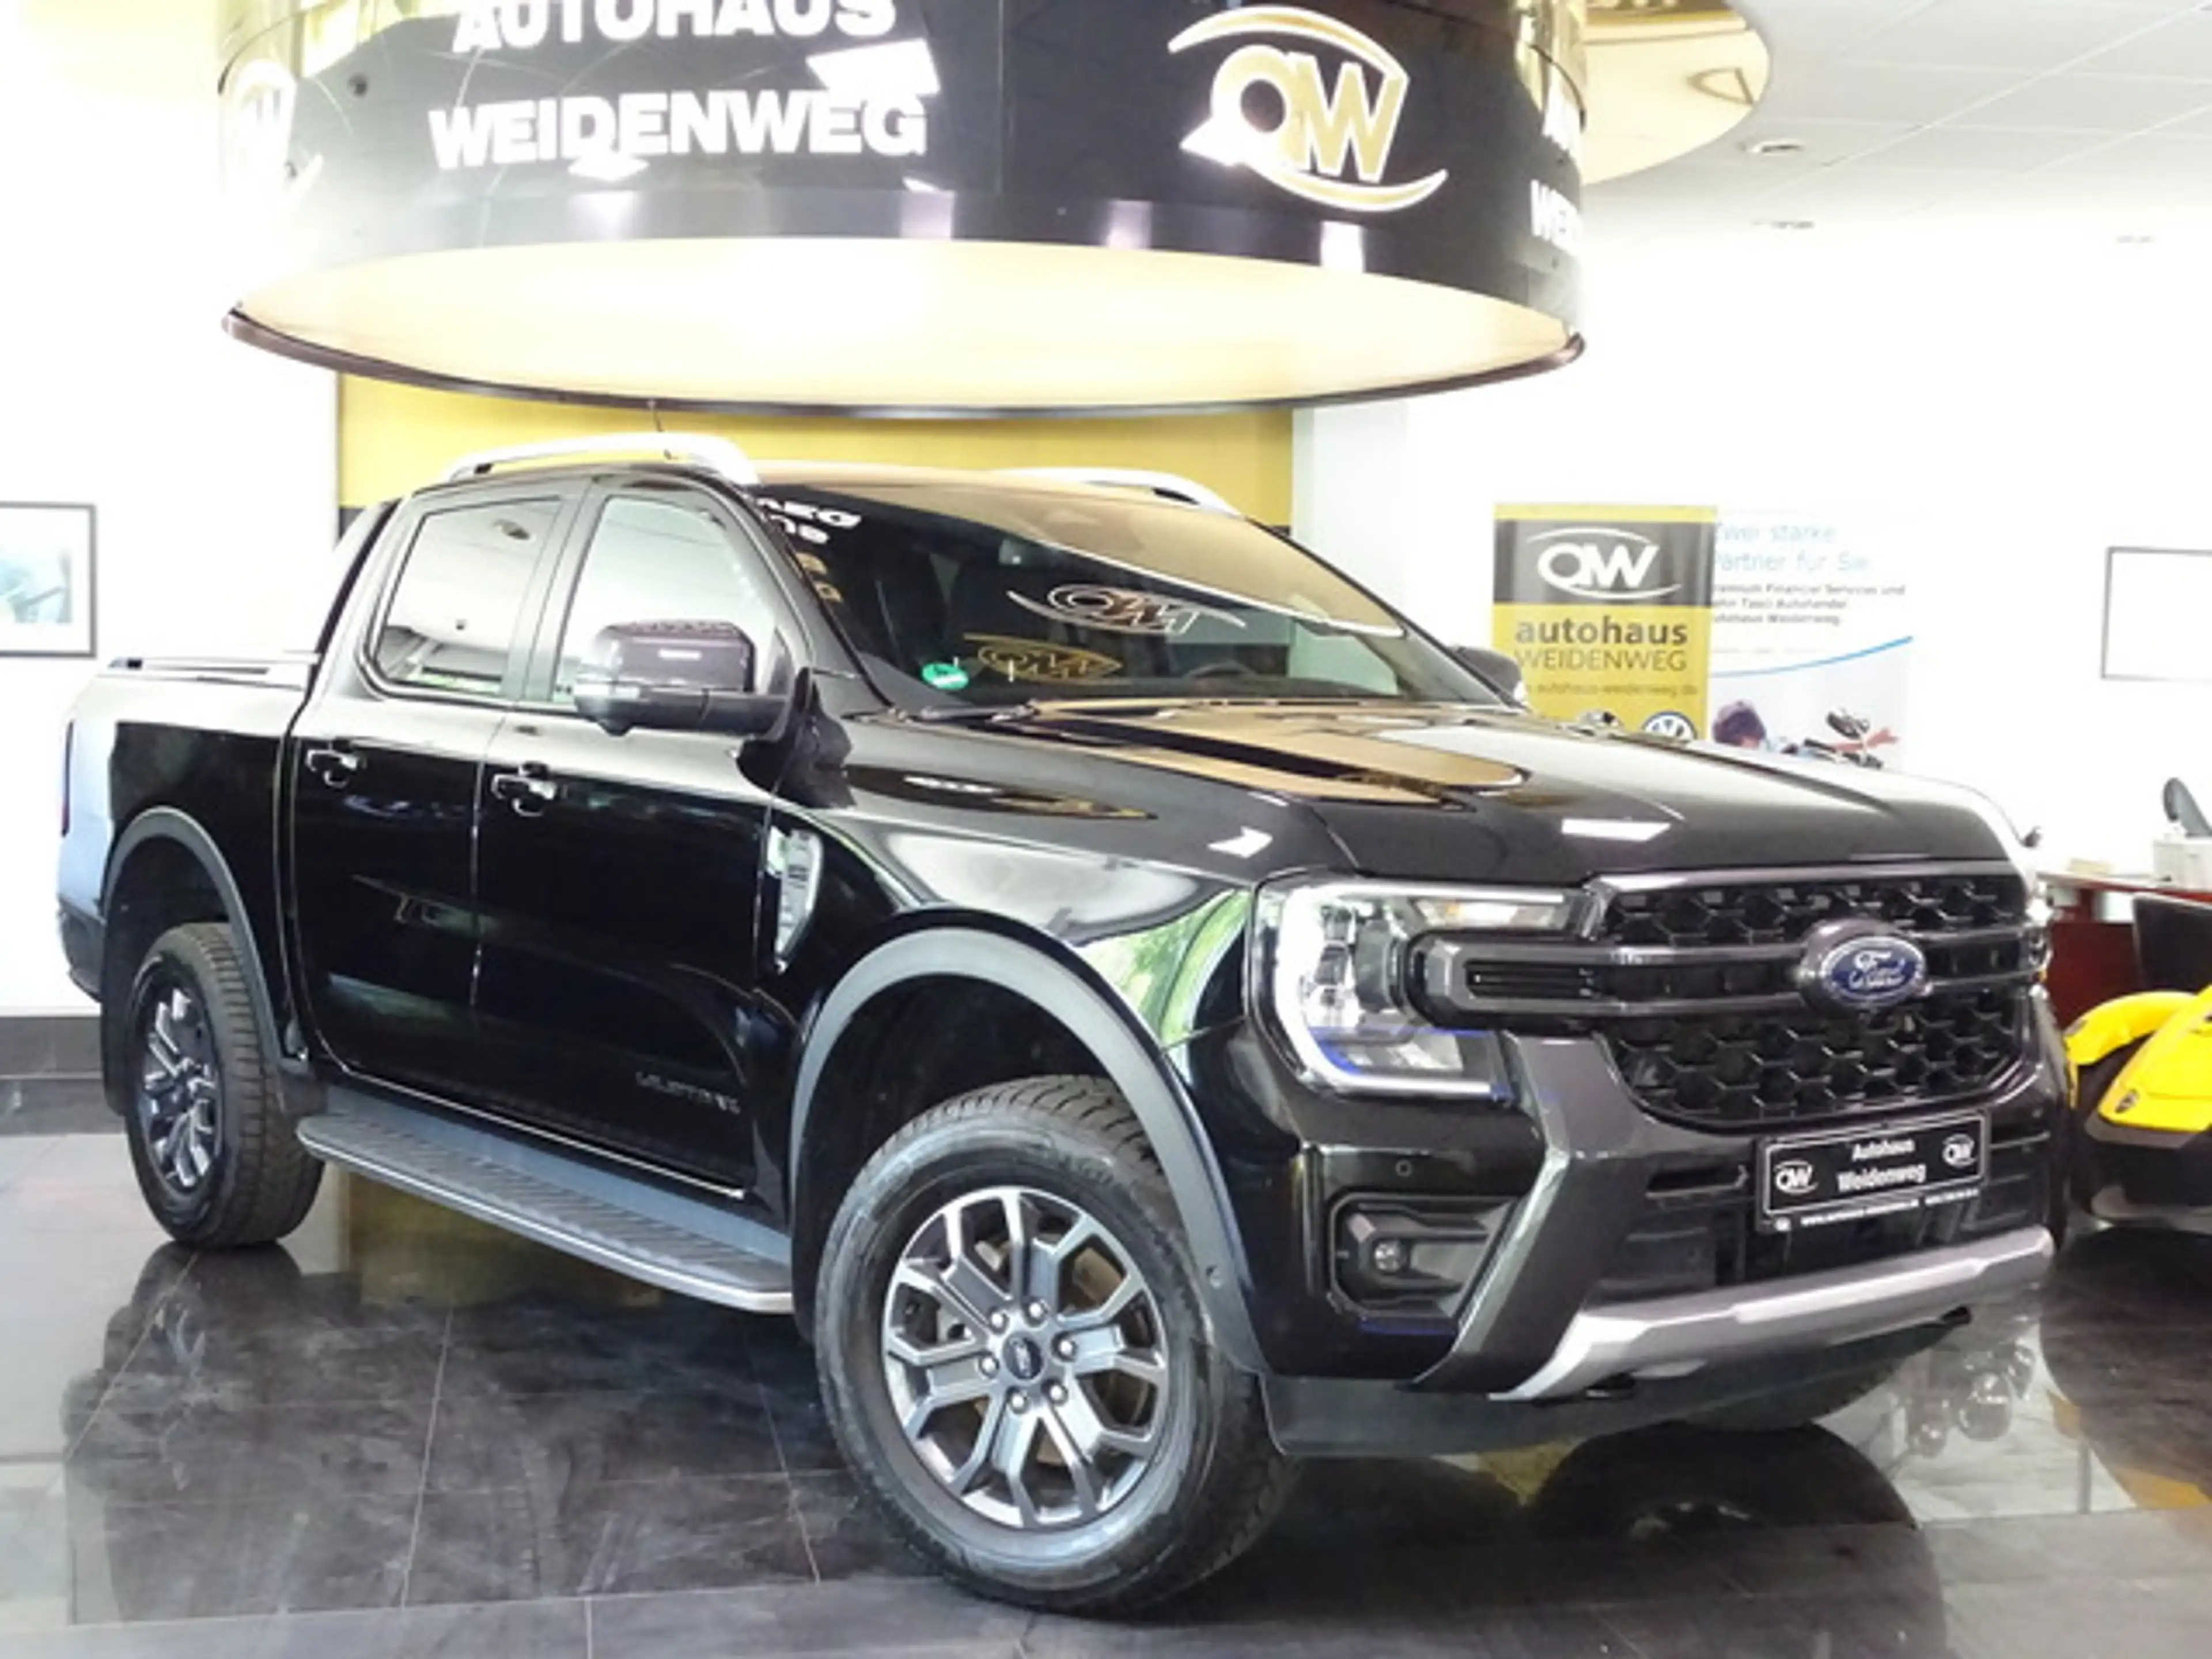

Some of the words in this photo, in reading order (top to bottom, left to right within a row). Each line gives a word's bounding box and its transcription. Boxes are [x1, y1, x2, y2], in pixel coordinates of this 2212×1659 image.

[429, 88, 927, 171] WEIDENWEG
[1514, 615, 1688, 646] autohaus
[1514, 647, 1688, 672] WEIDENWEG
